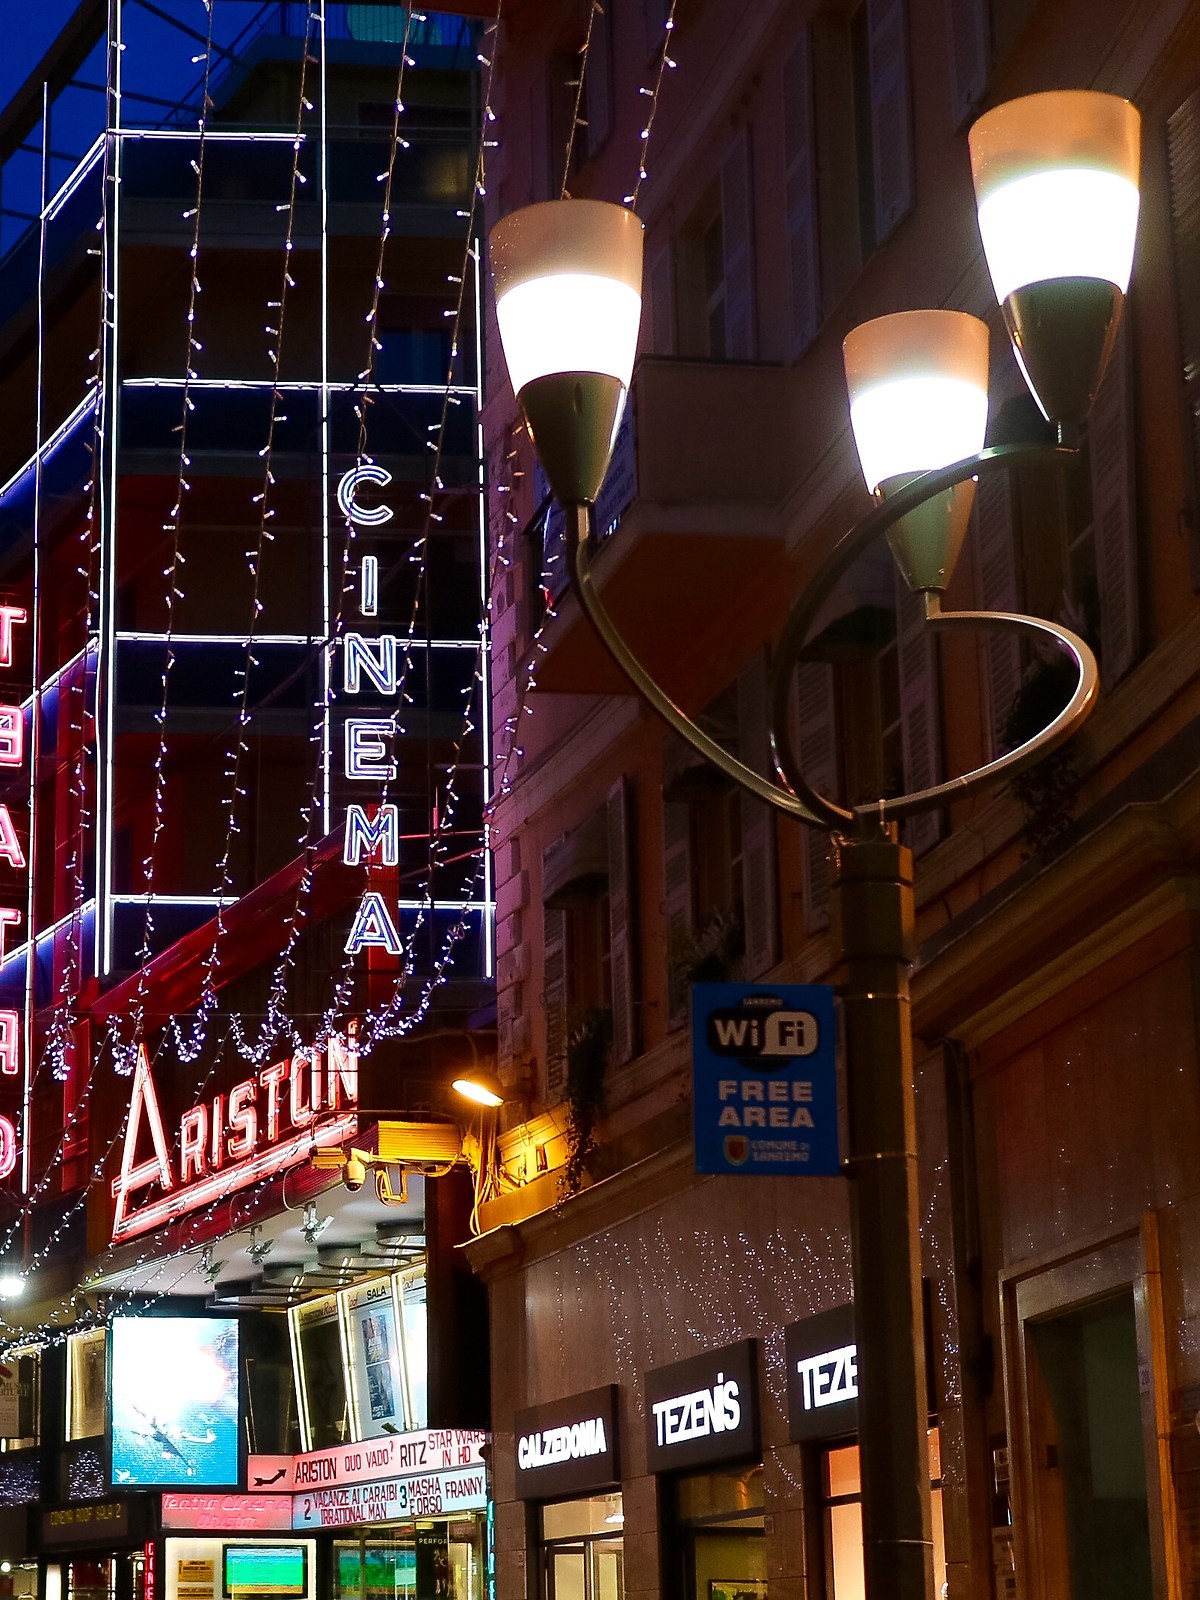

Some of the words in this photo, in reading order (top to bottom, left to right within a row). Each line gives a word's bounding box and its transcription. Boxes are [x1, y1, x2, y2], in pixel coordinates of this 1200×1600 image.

[337, 465, 403, 954] CINEMA
[717, 1080, 813, 1101] FREE
[717, 1106, 815, 1127] AREA
[752, 1140, 797, 1150] COMUNE
[752, 1152, 810, 1162] SANREMO
[366, 1286, 387, 1300] SALA
[517, 1417, 607, 1470] CALZEDONIA
[295, 1457, 337, 1483] ARISTON
[344, 1454, 362, 1472] QUO
[400, 1441, 427, 1467] RITZ
[428, 1430, 452, 1450] STAR
[442, 1449, 451, 1467] IN
[458, 1446, 471, 1464] HD
[304, 1498, 312, 1520] 2
[312, 1488, 349, 1509] VACANZE
[362, 1483, 398, 1504] CARAIBI
[400, 1485, 408, 1508] 3
[408, 1477, 442, 1497] MASHA
[445, 1476, 484, 1500] FRANNY
[320, 1503, 366, 1525] IRRATIONAL
[368, 1501, 387, 1520] MAN
[417, 1495, 443, 1514] ORSO
